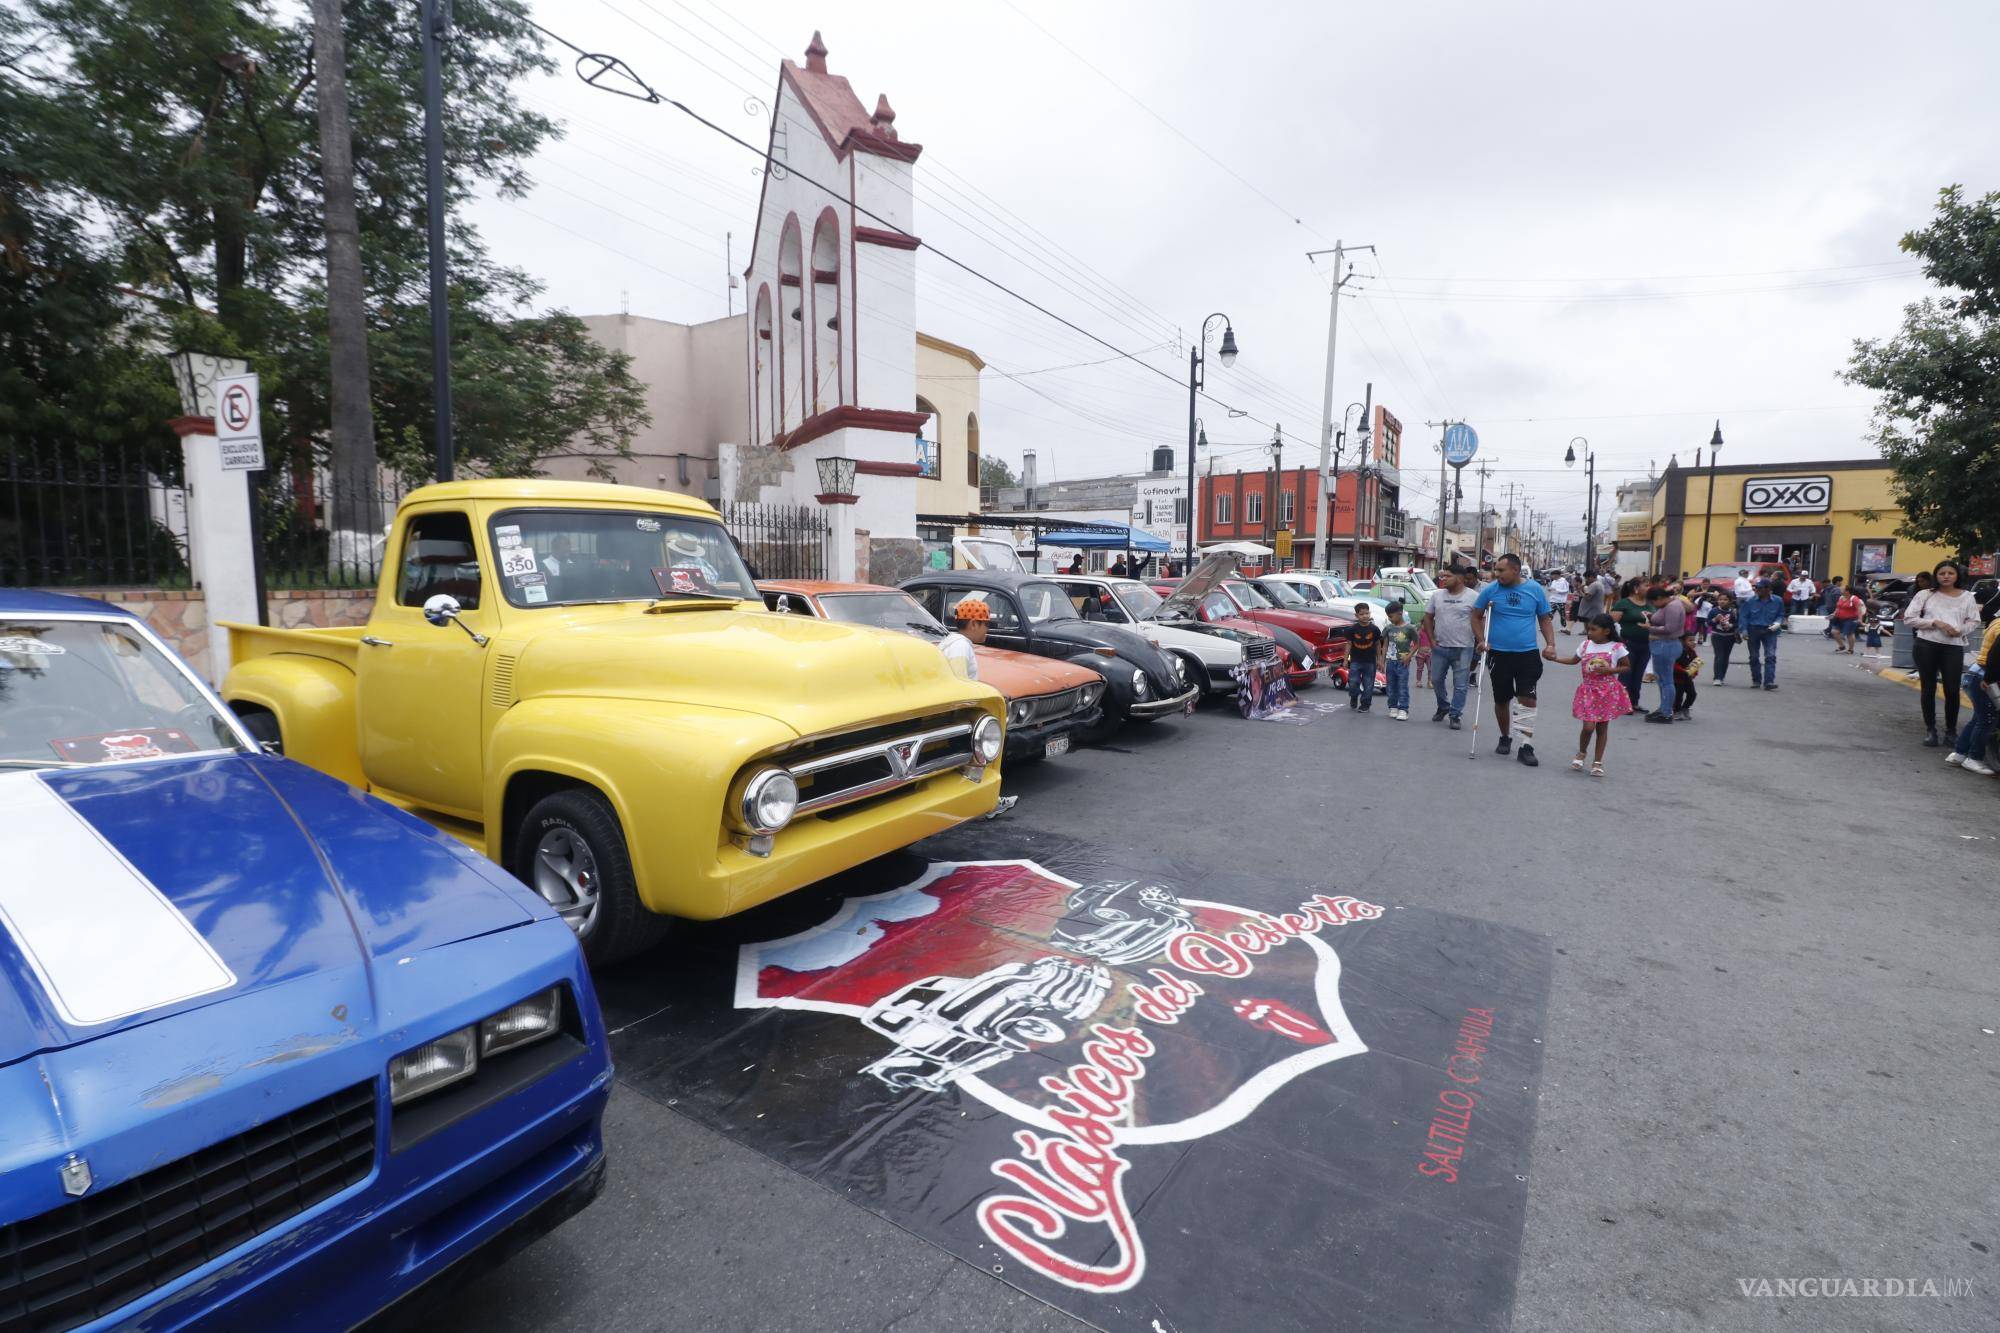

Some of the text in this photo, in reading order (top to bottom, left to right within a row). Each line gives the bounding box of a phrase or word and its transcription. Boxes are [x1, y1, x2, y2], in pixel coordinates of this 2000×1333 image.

[222, 443, 259, 455] EXCLUSIVO
[224, 455, 260, 466] CARROZAS
[1749, 481, 1826, 508] OXXO
[504, 559, 534, 573] 350
[1447, 1007, 1497, 1084] COAHUILA
[976, 895, 1385, 1293] Clásicos del Desierto
